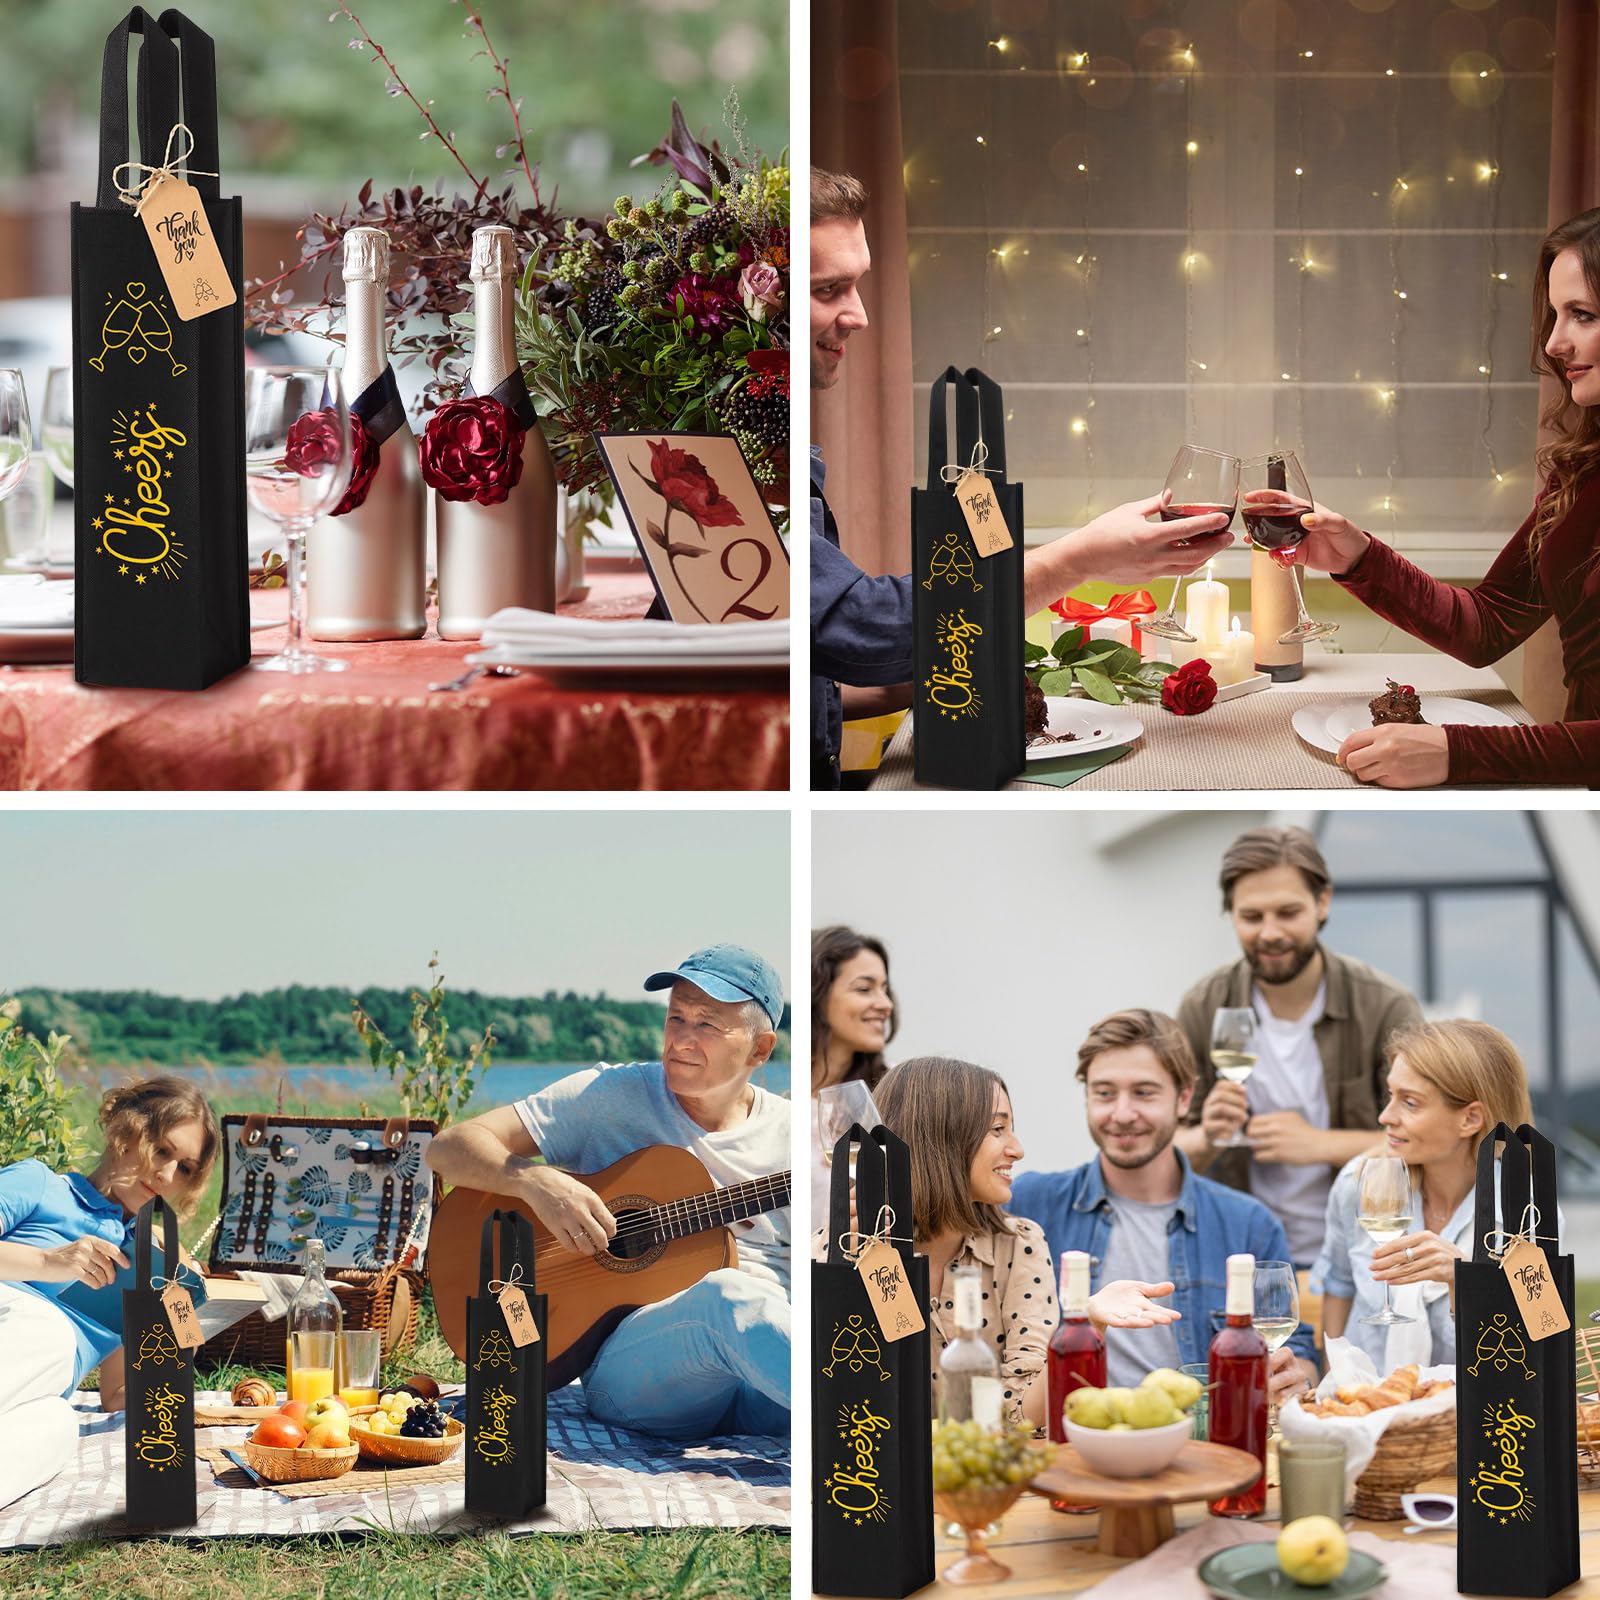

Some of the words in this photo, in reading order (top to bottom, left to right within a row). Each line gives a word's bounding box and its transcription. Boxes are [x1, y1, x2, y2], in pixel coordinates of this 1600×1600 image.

[156, 210, 205, 242] thank
[174, 237, 198, 264] you
[103, 411, 187, 564] Cheers
[965, 492, 995, 512] thank
[976, 508, 991, 524] you
[719, 538, 779, 622] 2
[930, 613, 983, 708] Cheers
[869, 1265, 904, 1287] thank
[1514, 1264, 1549, 1287] thank
[1526, 1282, 1543, 1301] you
[881, 1283, 898, 1302] you
[140, 1387, 186, 1462] Cheers
[478, 1388, 517, 1457] Cheers
[832, 1405, 891, 1511] Cheers
[1477, 1404, 1536, 1510] Cheers
